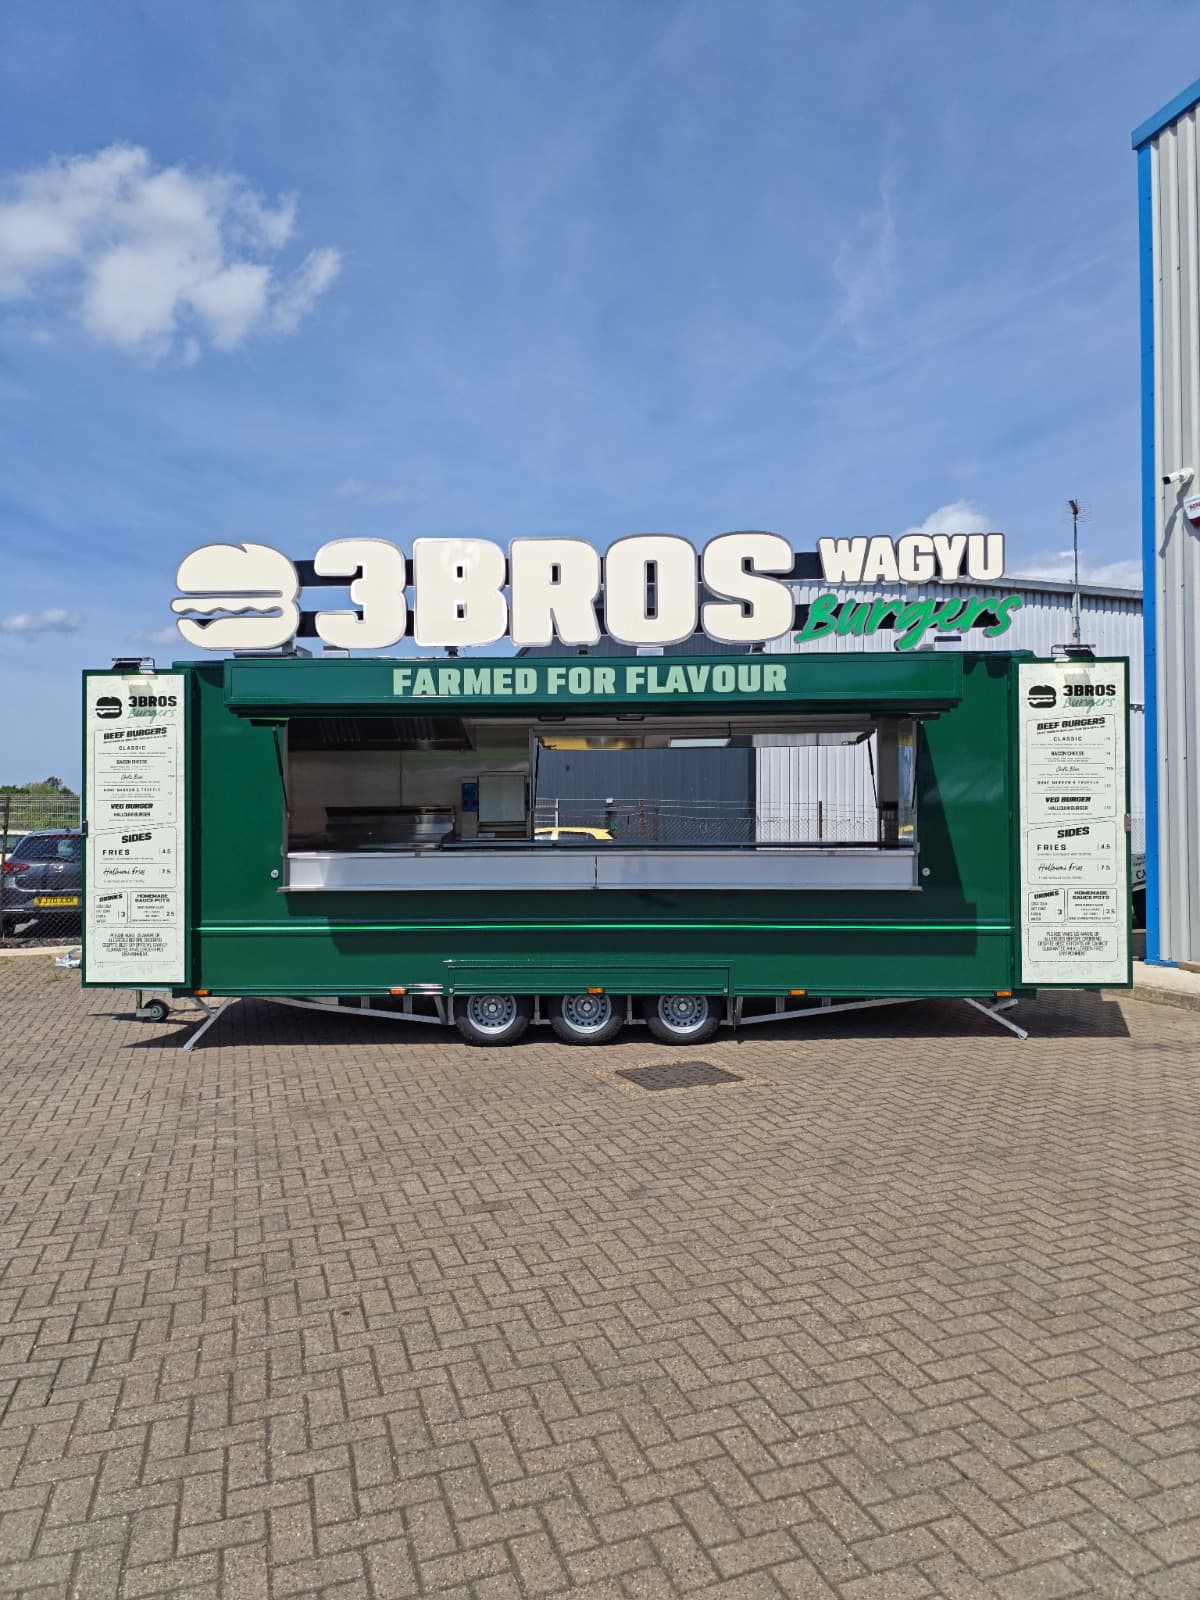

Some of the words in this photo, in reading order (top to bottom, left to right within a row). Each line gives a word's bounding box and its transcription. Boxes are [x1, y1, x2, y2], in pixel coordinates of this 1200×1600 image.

[817, 533, 1006, 585] WAGYU
[313, 531, 796, 649] 3BROS
[794, 594, 1023, 651] Burgers
[392, 667, 538, 696] FARMED
[547, 666, 616, 695] FOR
[626, 664, 788, 694] FLAVOUR
[1062, 684, 1116, 697] 3BROS
[128, 695, 177, 708] 3BROS
[1062, 697, 1116, 714] Burgers
[127, 707, 176, 724] Burgers
[1036, 722, 1060, 731] BEEF
[1061, 717, 1105, 728] BURGERS
[103, 731, 125, 740] BEEF
[126, 727, 167, 738] BURGERS
[121, 832, 153, 844] SIDES
[1056, 826, 1090, 838] SIDES
[1033, 890, 1060, 899] DRINKS
